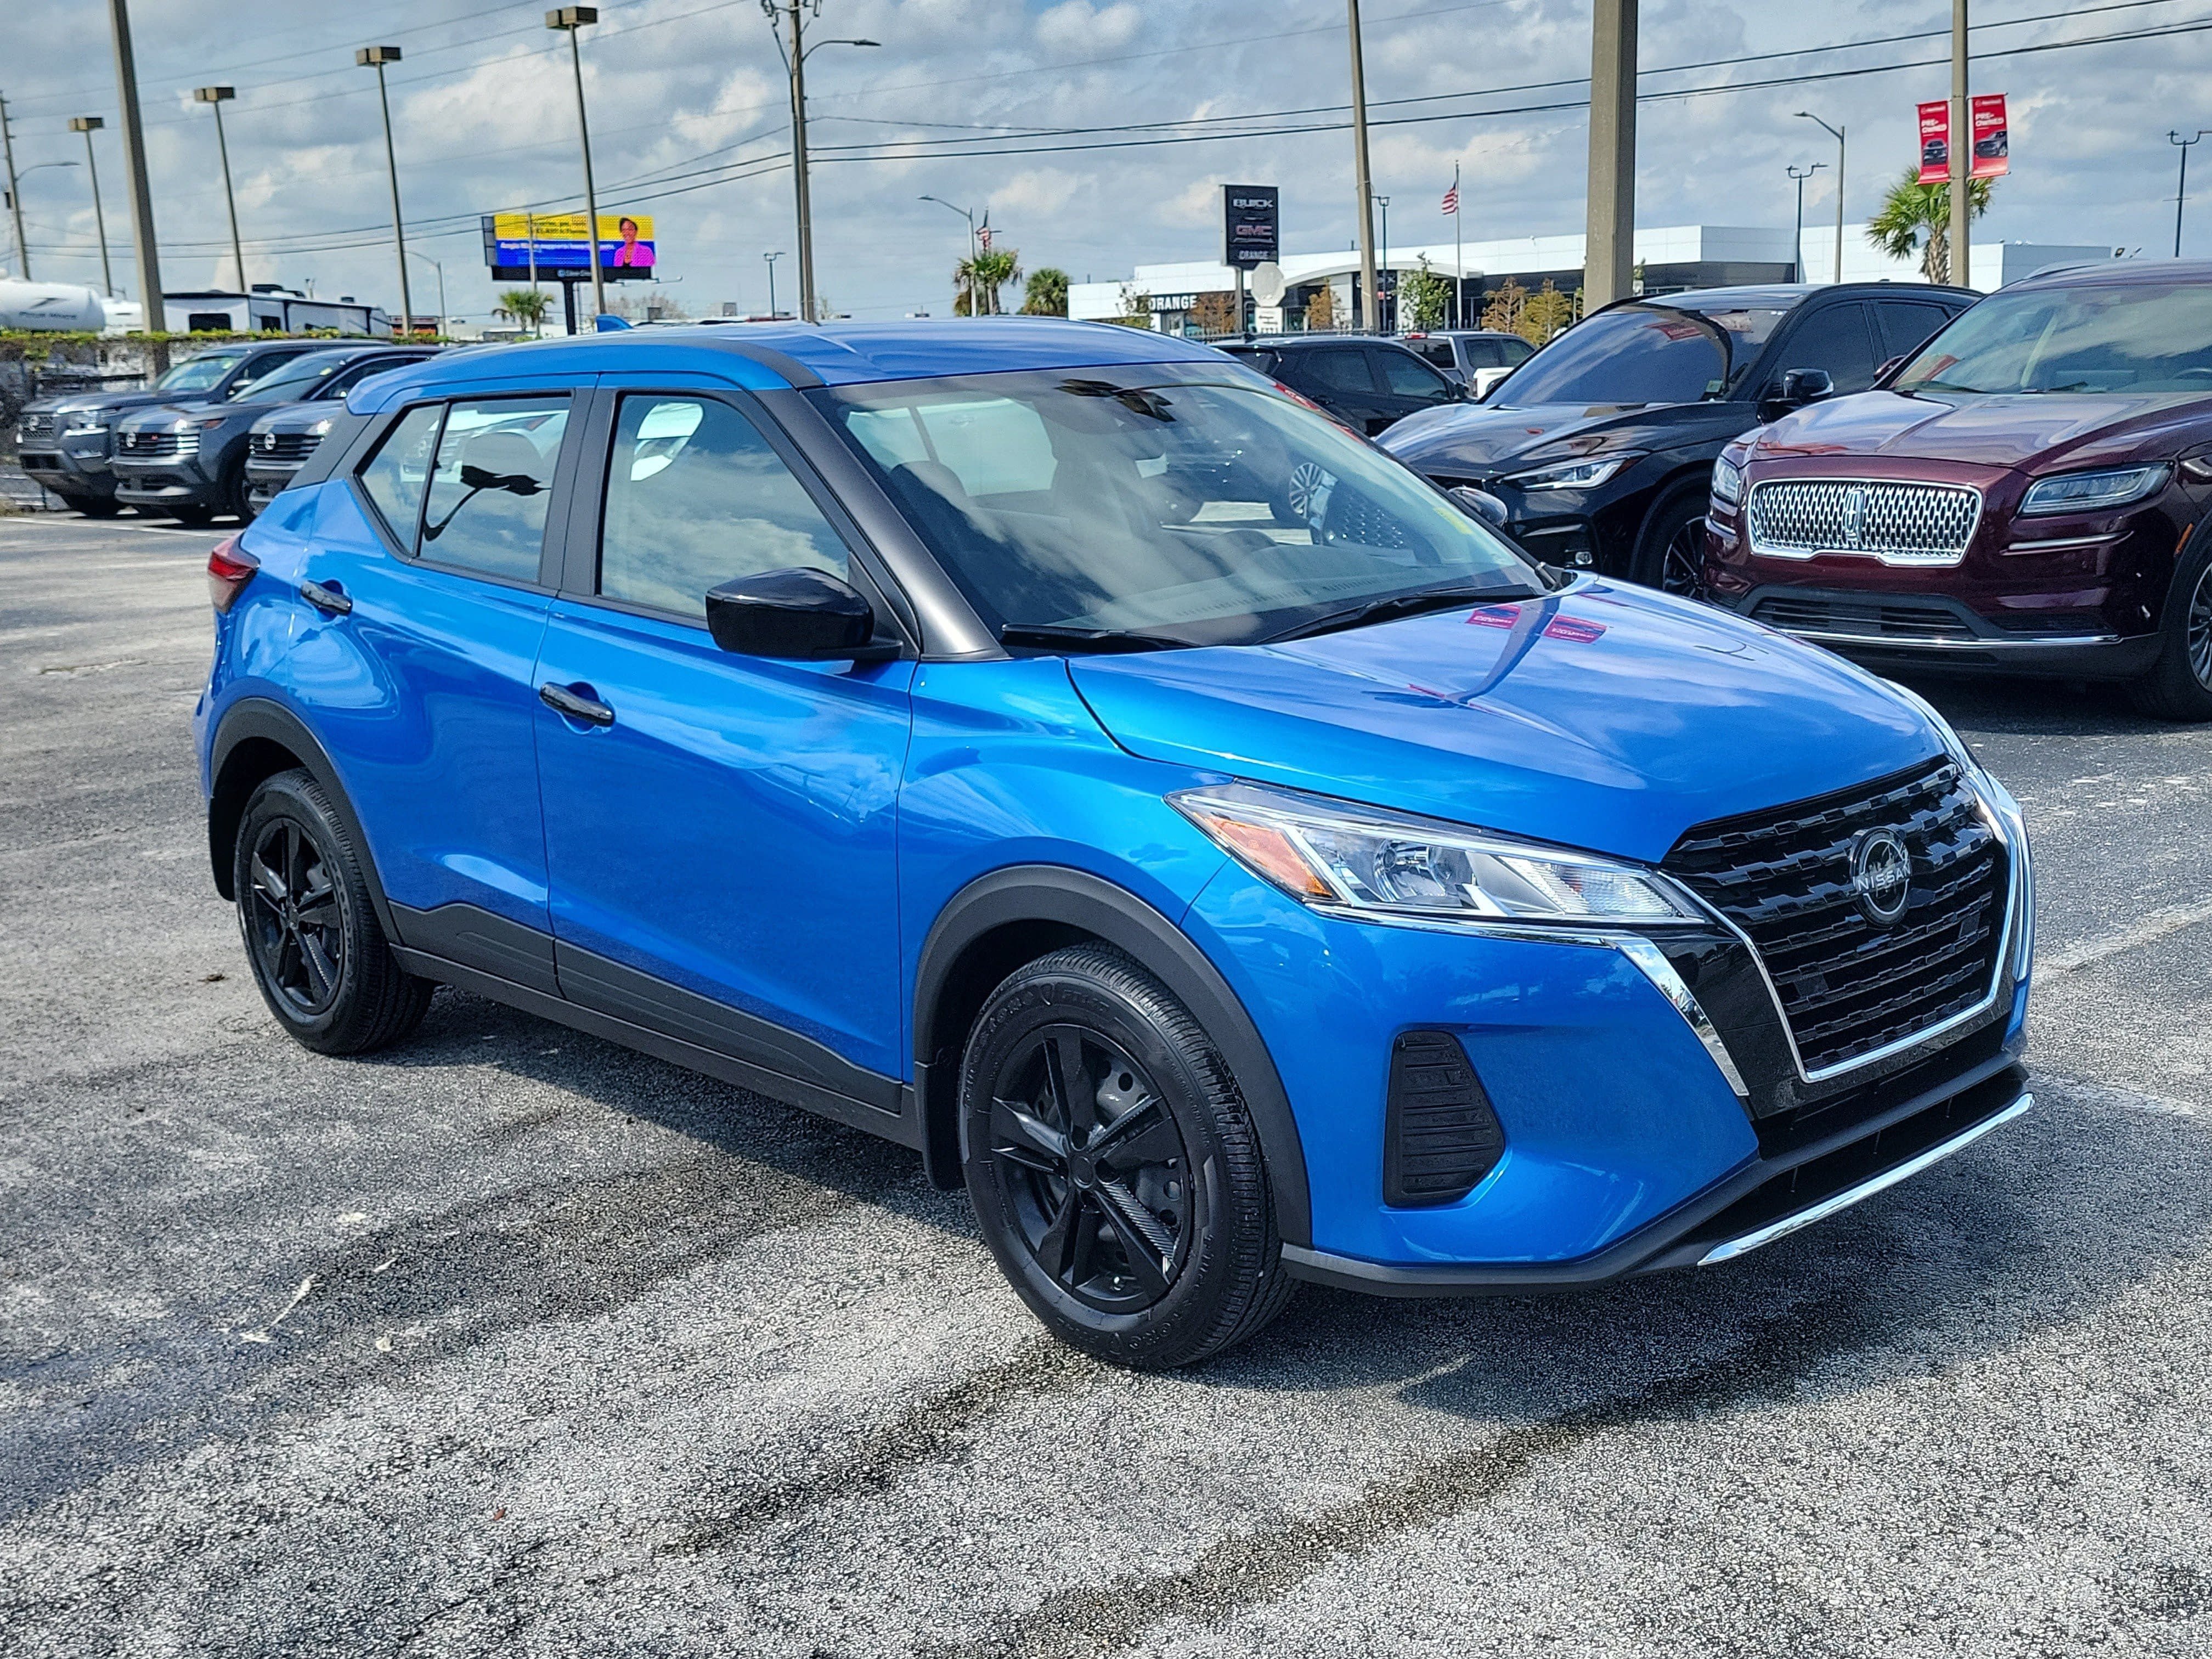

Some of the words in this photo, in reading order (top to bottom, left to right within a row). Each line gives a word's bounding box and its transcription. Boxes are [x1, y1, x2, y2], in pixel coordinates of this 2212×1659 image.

[1233, 199, 1274, 208] BUICK
[1236, 225, 1272, 236] GMC
[1148, 295, 1197, 311] ORANGE
[1857, 863, 1911, 892] NISSAN
